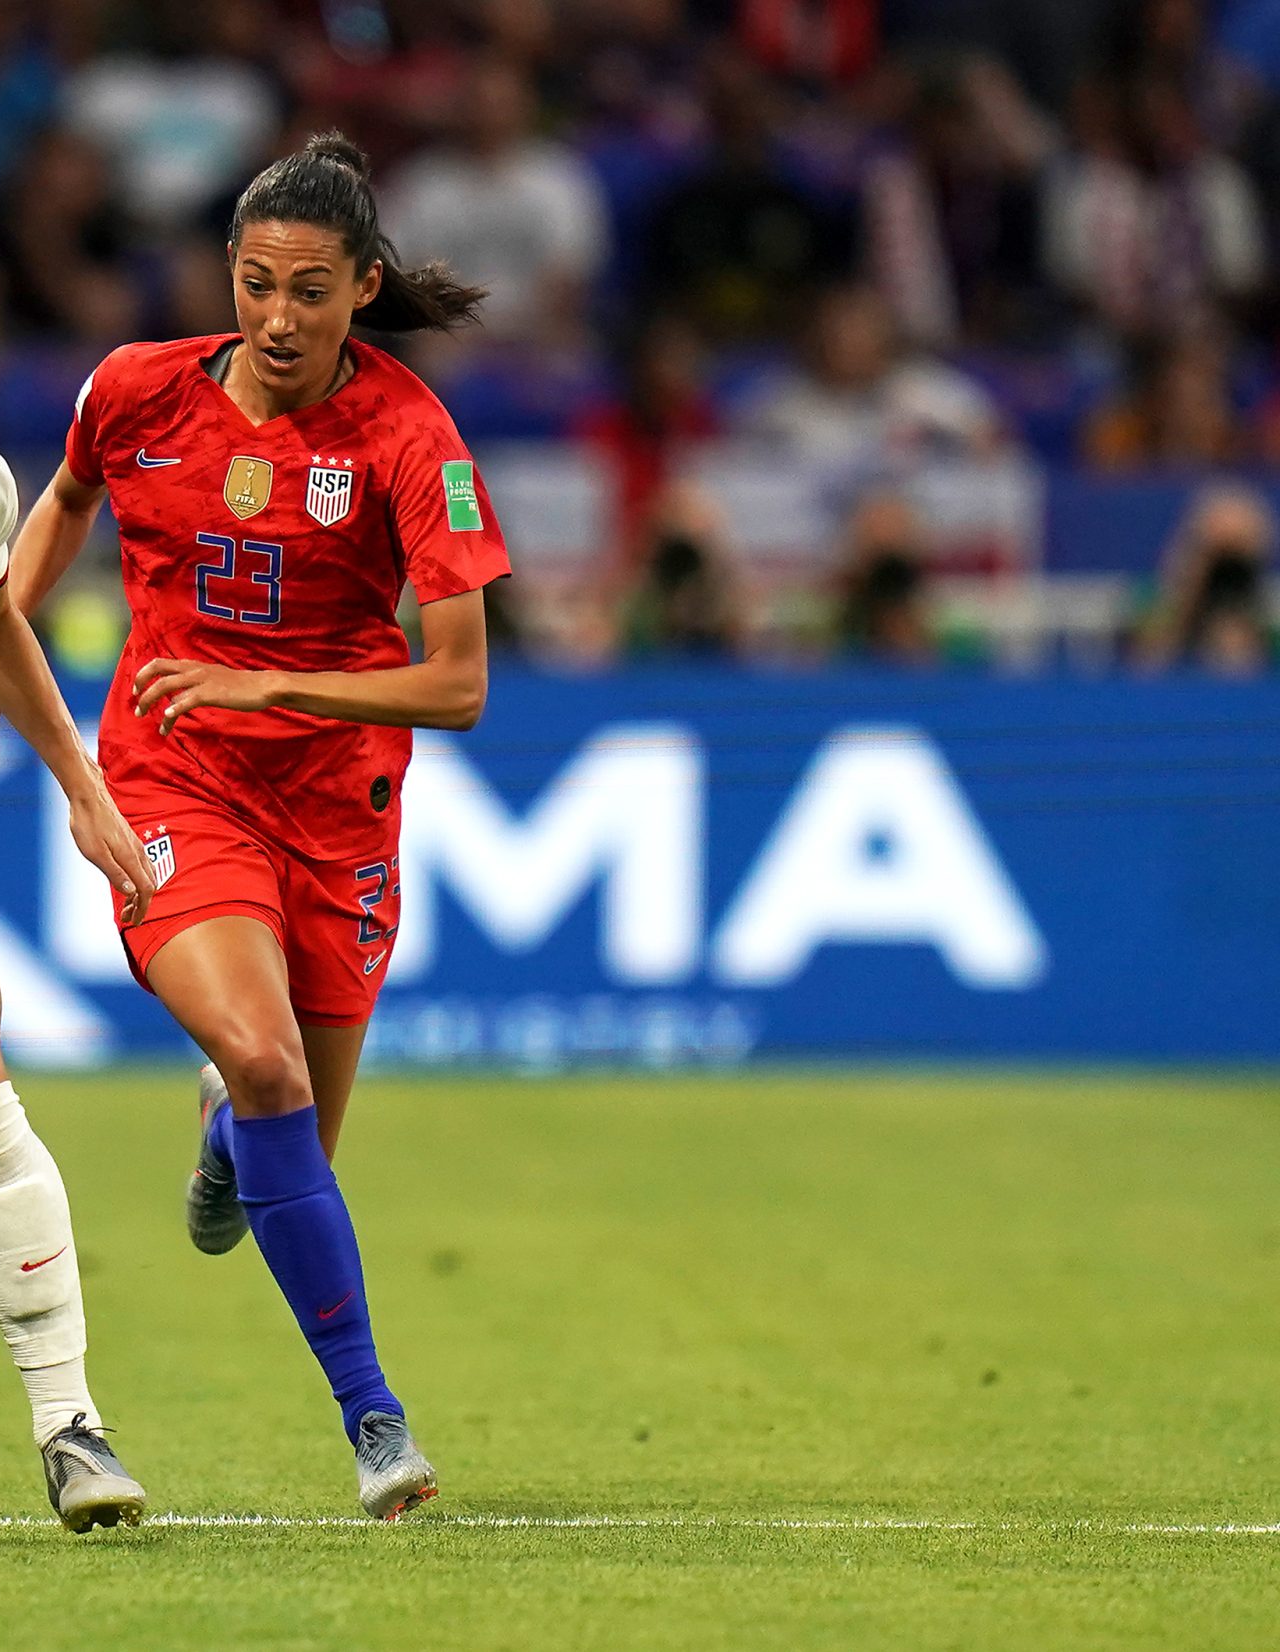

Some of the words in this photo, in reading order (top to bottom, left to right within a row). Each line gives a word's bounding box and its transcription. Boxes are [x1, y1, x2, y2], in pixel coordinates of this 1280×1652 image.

[312, 471, 349, 494] USA
[235, 494, 256, 505] FIFA
[195, 531, 283, 625] 23
[146, 840, 168, 863] SA
